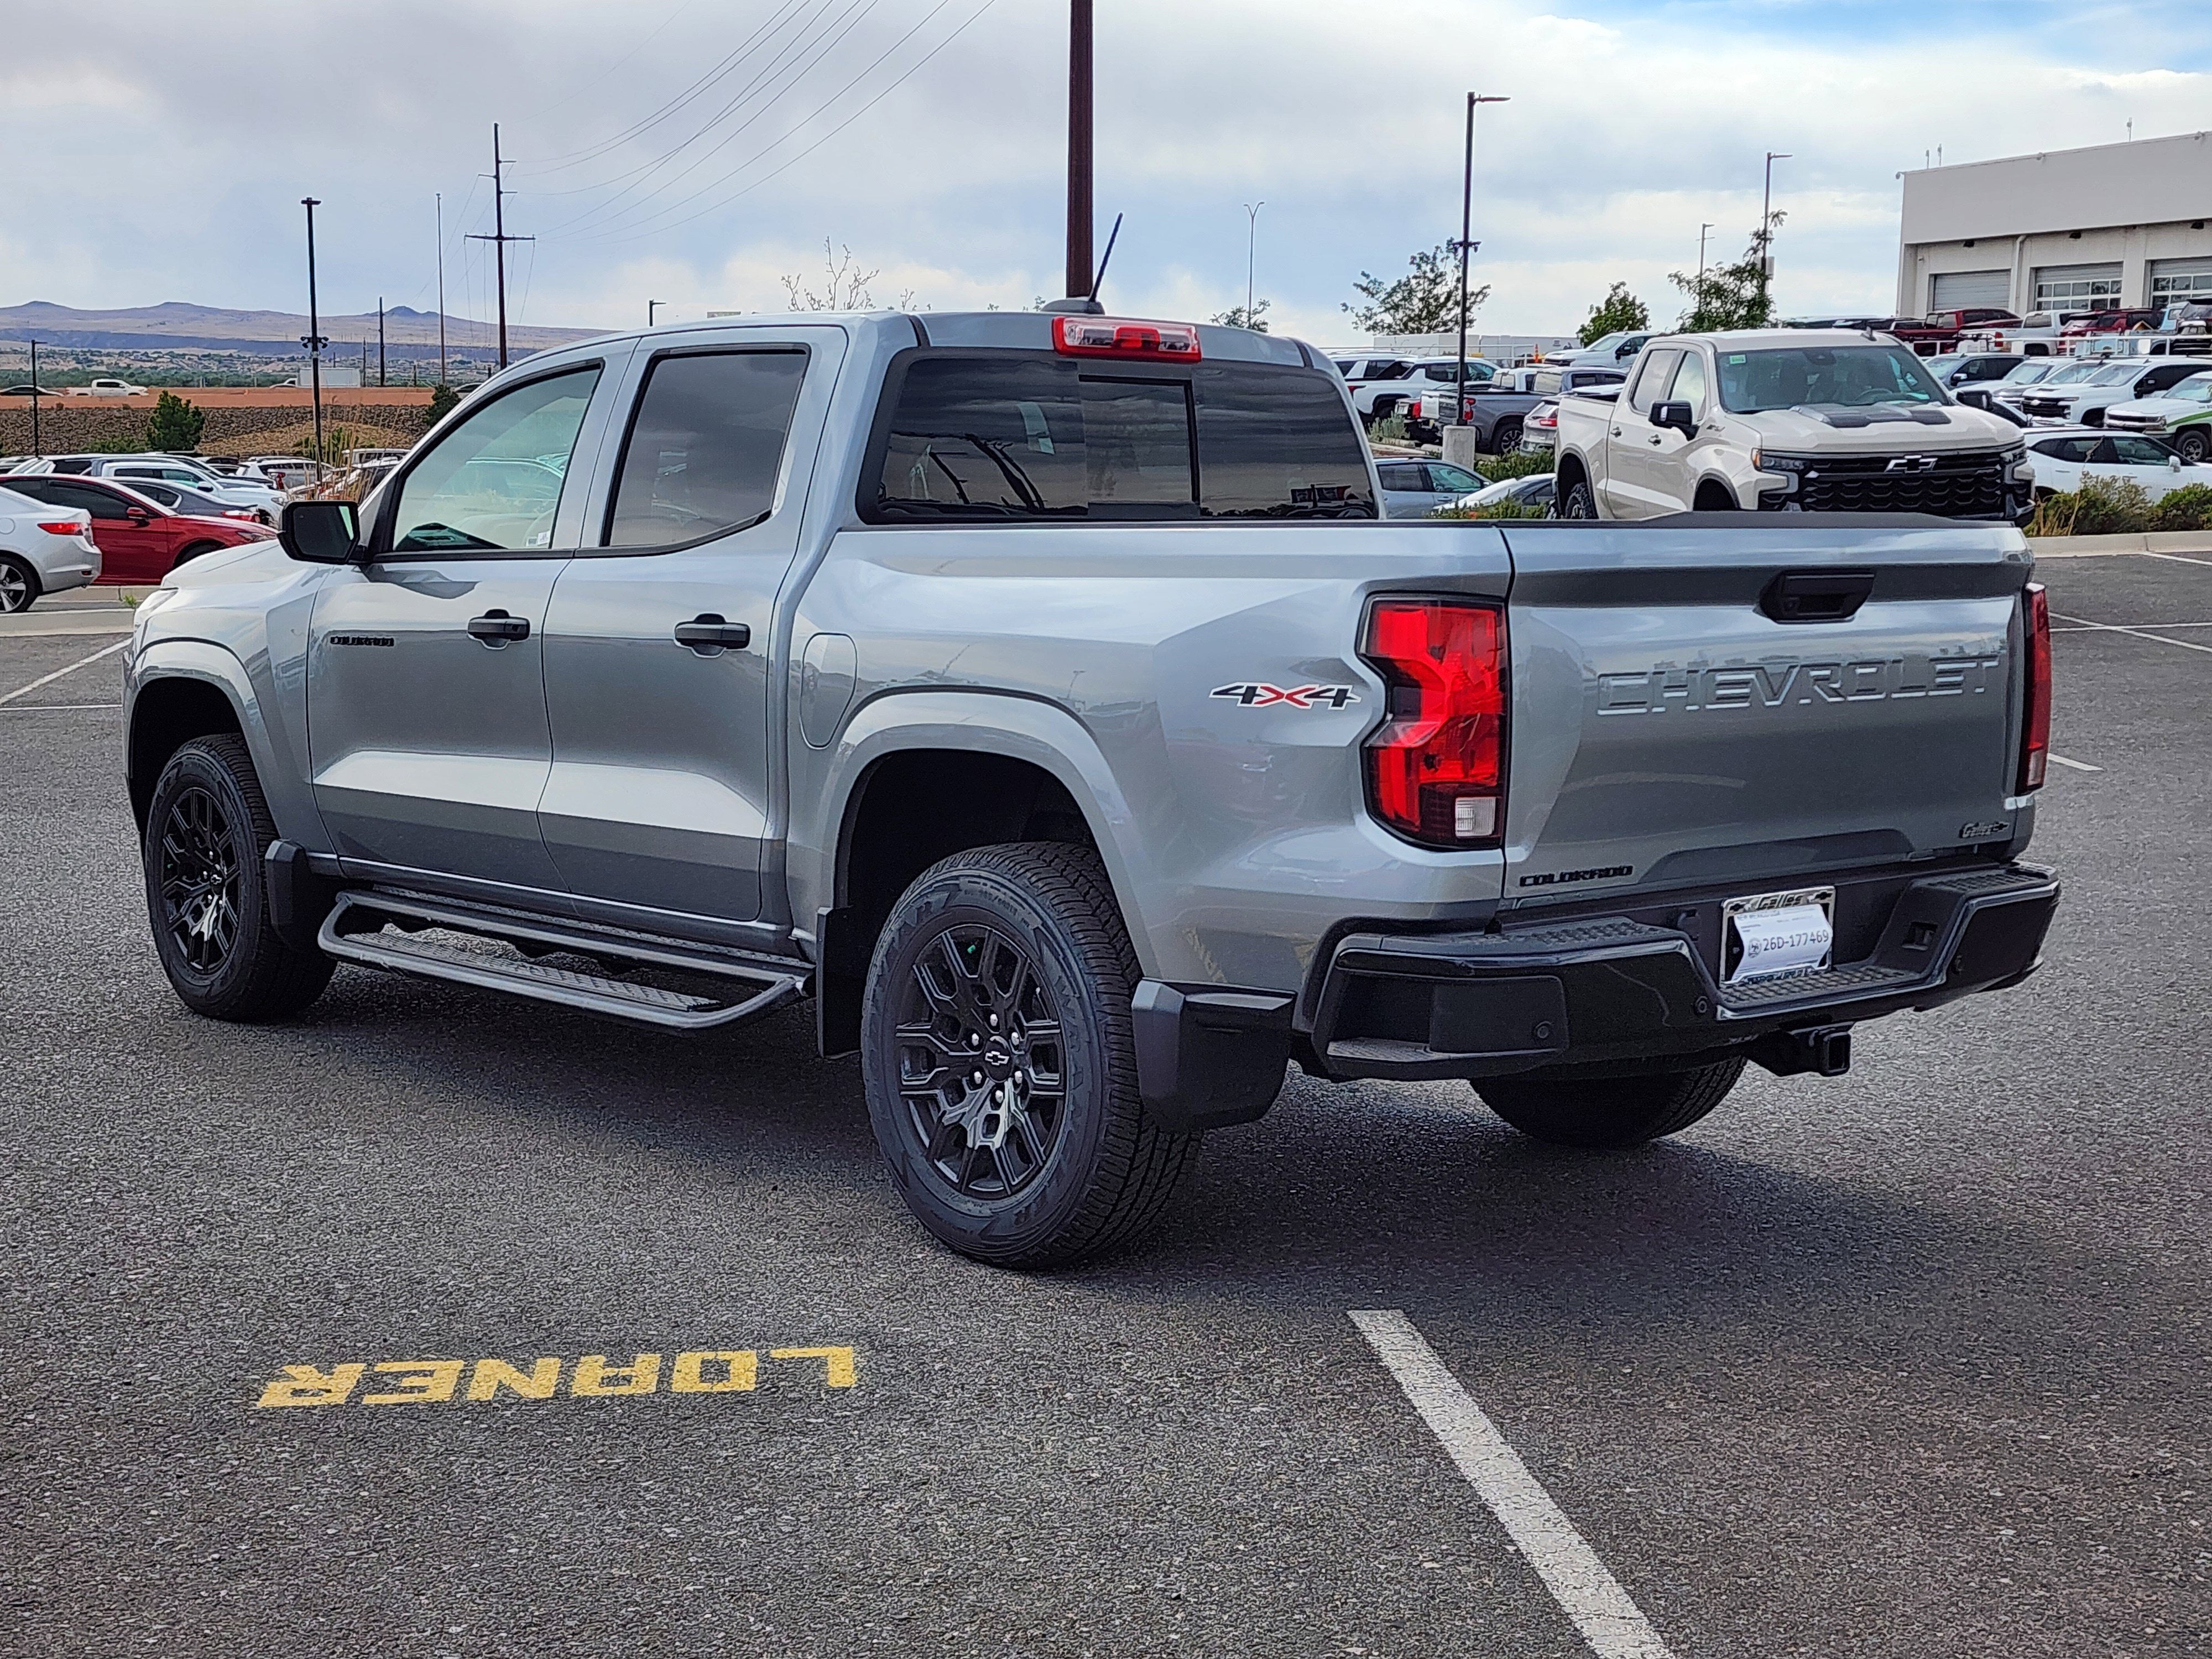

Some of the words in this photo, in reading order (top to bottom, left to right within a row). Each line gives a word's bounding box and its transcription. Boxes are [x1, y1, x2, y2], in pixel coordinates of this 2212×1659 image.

[1598, 656, 1999, 714] CHEVROLET
[1520, 865, 1634, 887] COLORADO
[1755, 893, 1804, 911] Galles
[1763, 929, 1829, 951] 26D-177469
[257, 1345, 858, 1408] LOANER
